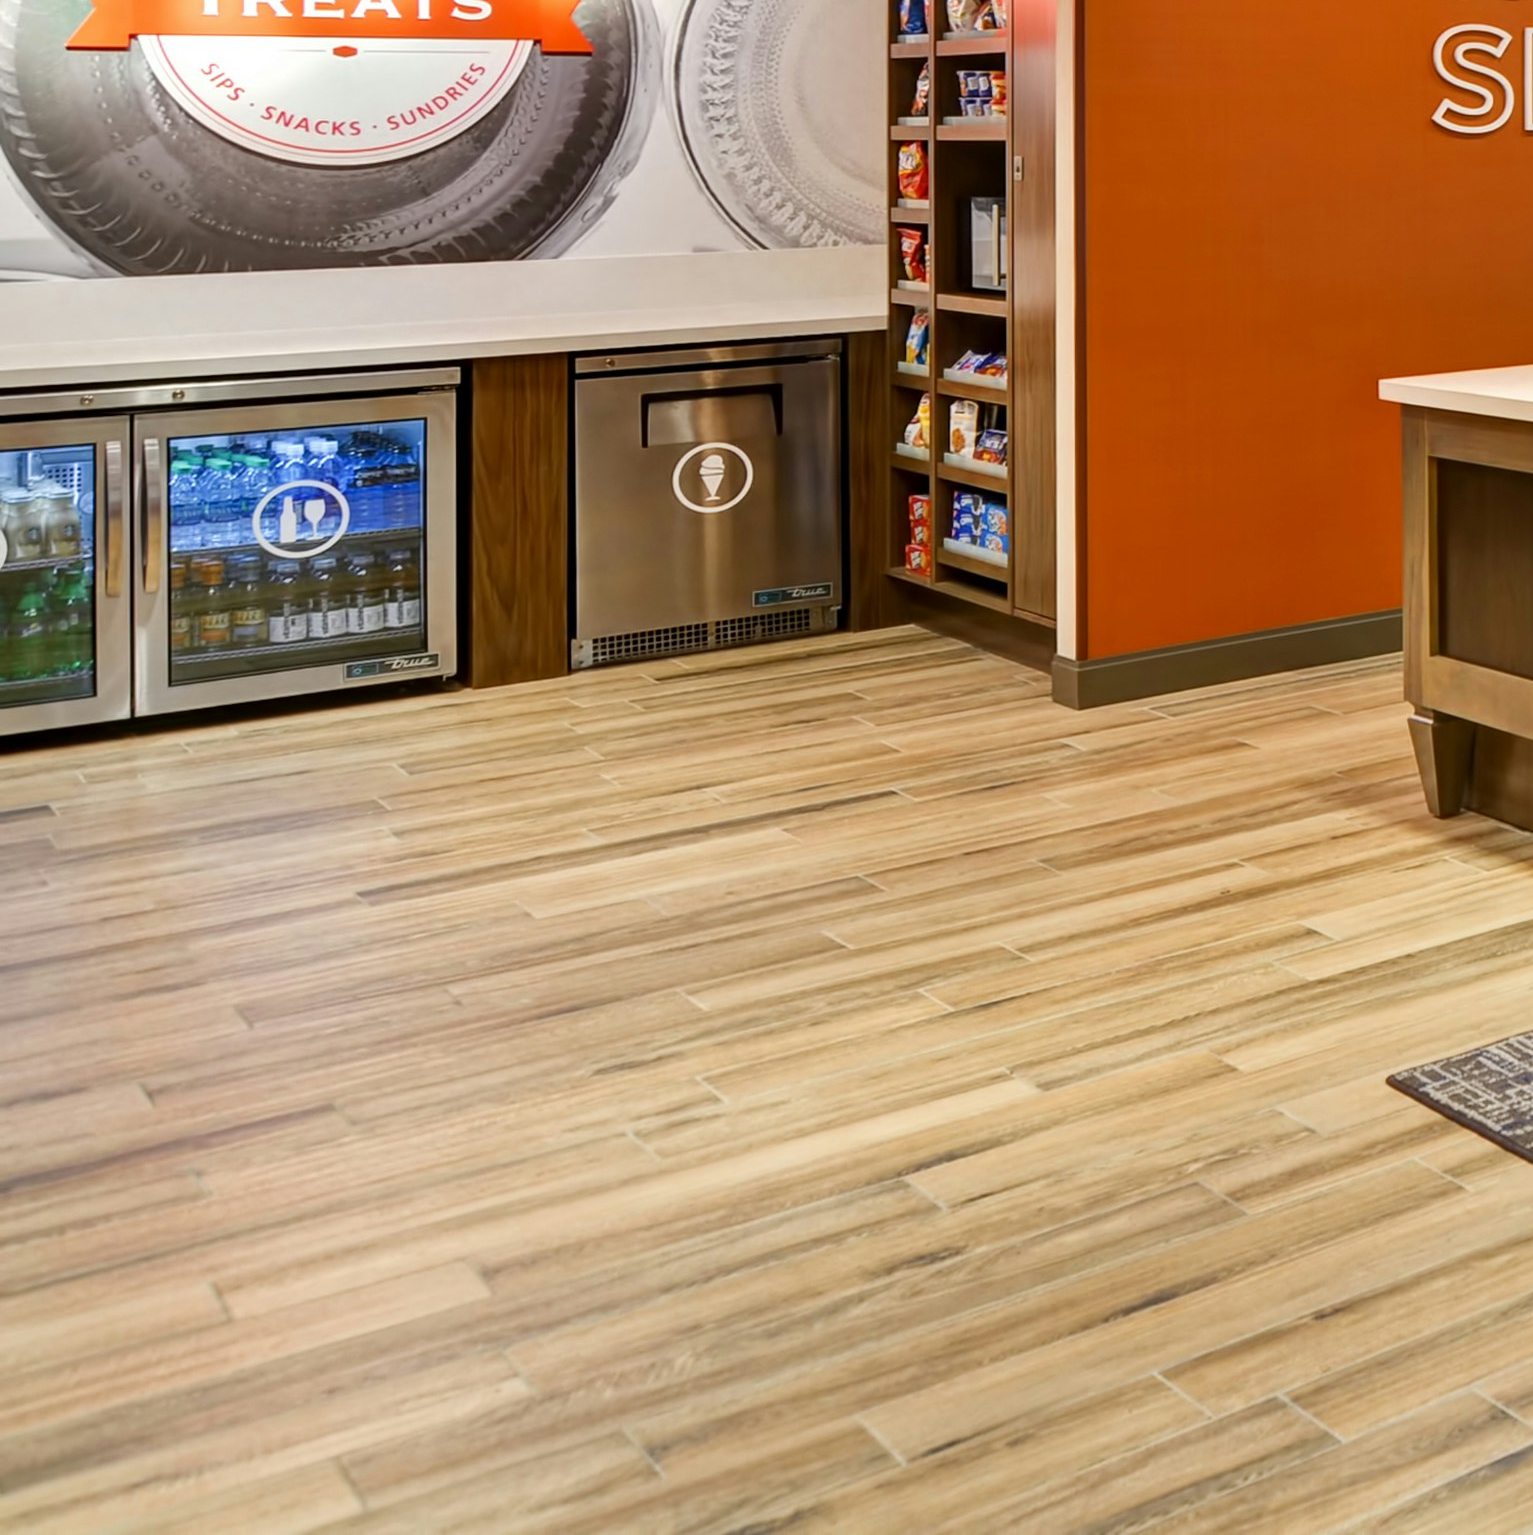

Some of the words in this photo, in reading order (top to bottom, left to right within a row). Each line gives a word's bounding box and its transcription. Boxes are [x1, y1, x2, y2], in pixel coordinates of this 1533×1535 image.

[201, 63, 245, 102] SIPS
[260, 105, 361, 136] SNACKS
[386, 62, 486, 131] SUNDRIES
[385, 657, 435, 670] True
